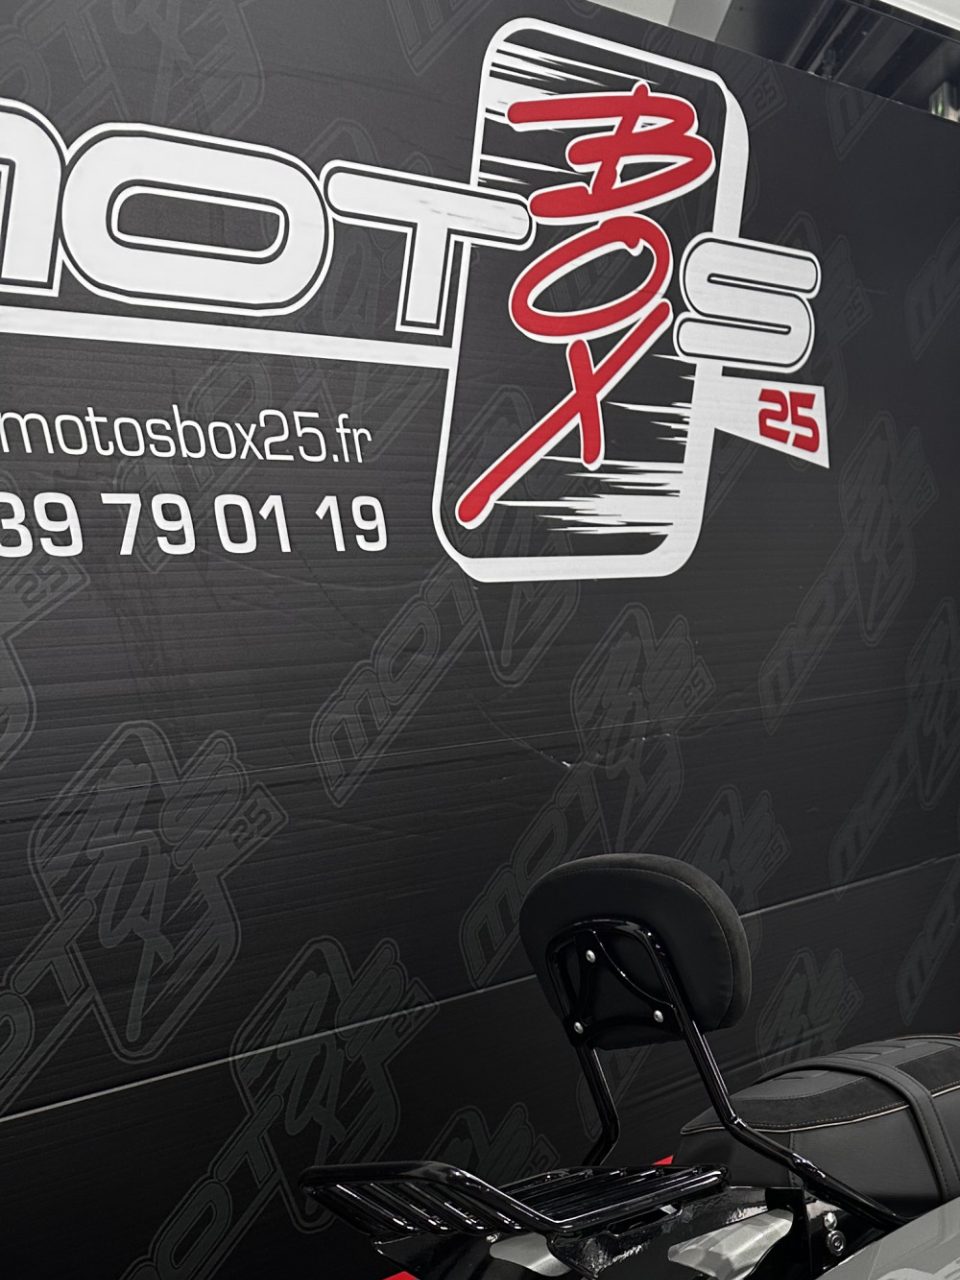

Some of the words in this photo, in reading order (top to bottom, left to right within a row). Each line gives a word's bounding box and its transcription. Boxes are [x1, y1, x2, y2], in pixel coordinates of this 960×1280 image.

[455, 81, 716, 529] BOX
[0, 404, 373, 464] motosbox25.fr
[757, 388, 820, 453] 25
[100, 493, 197, 556] 79
[214, 493, 292, 554] 01
[315, 495, 388, 552] 19
